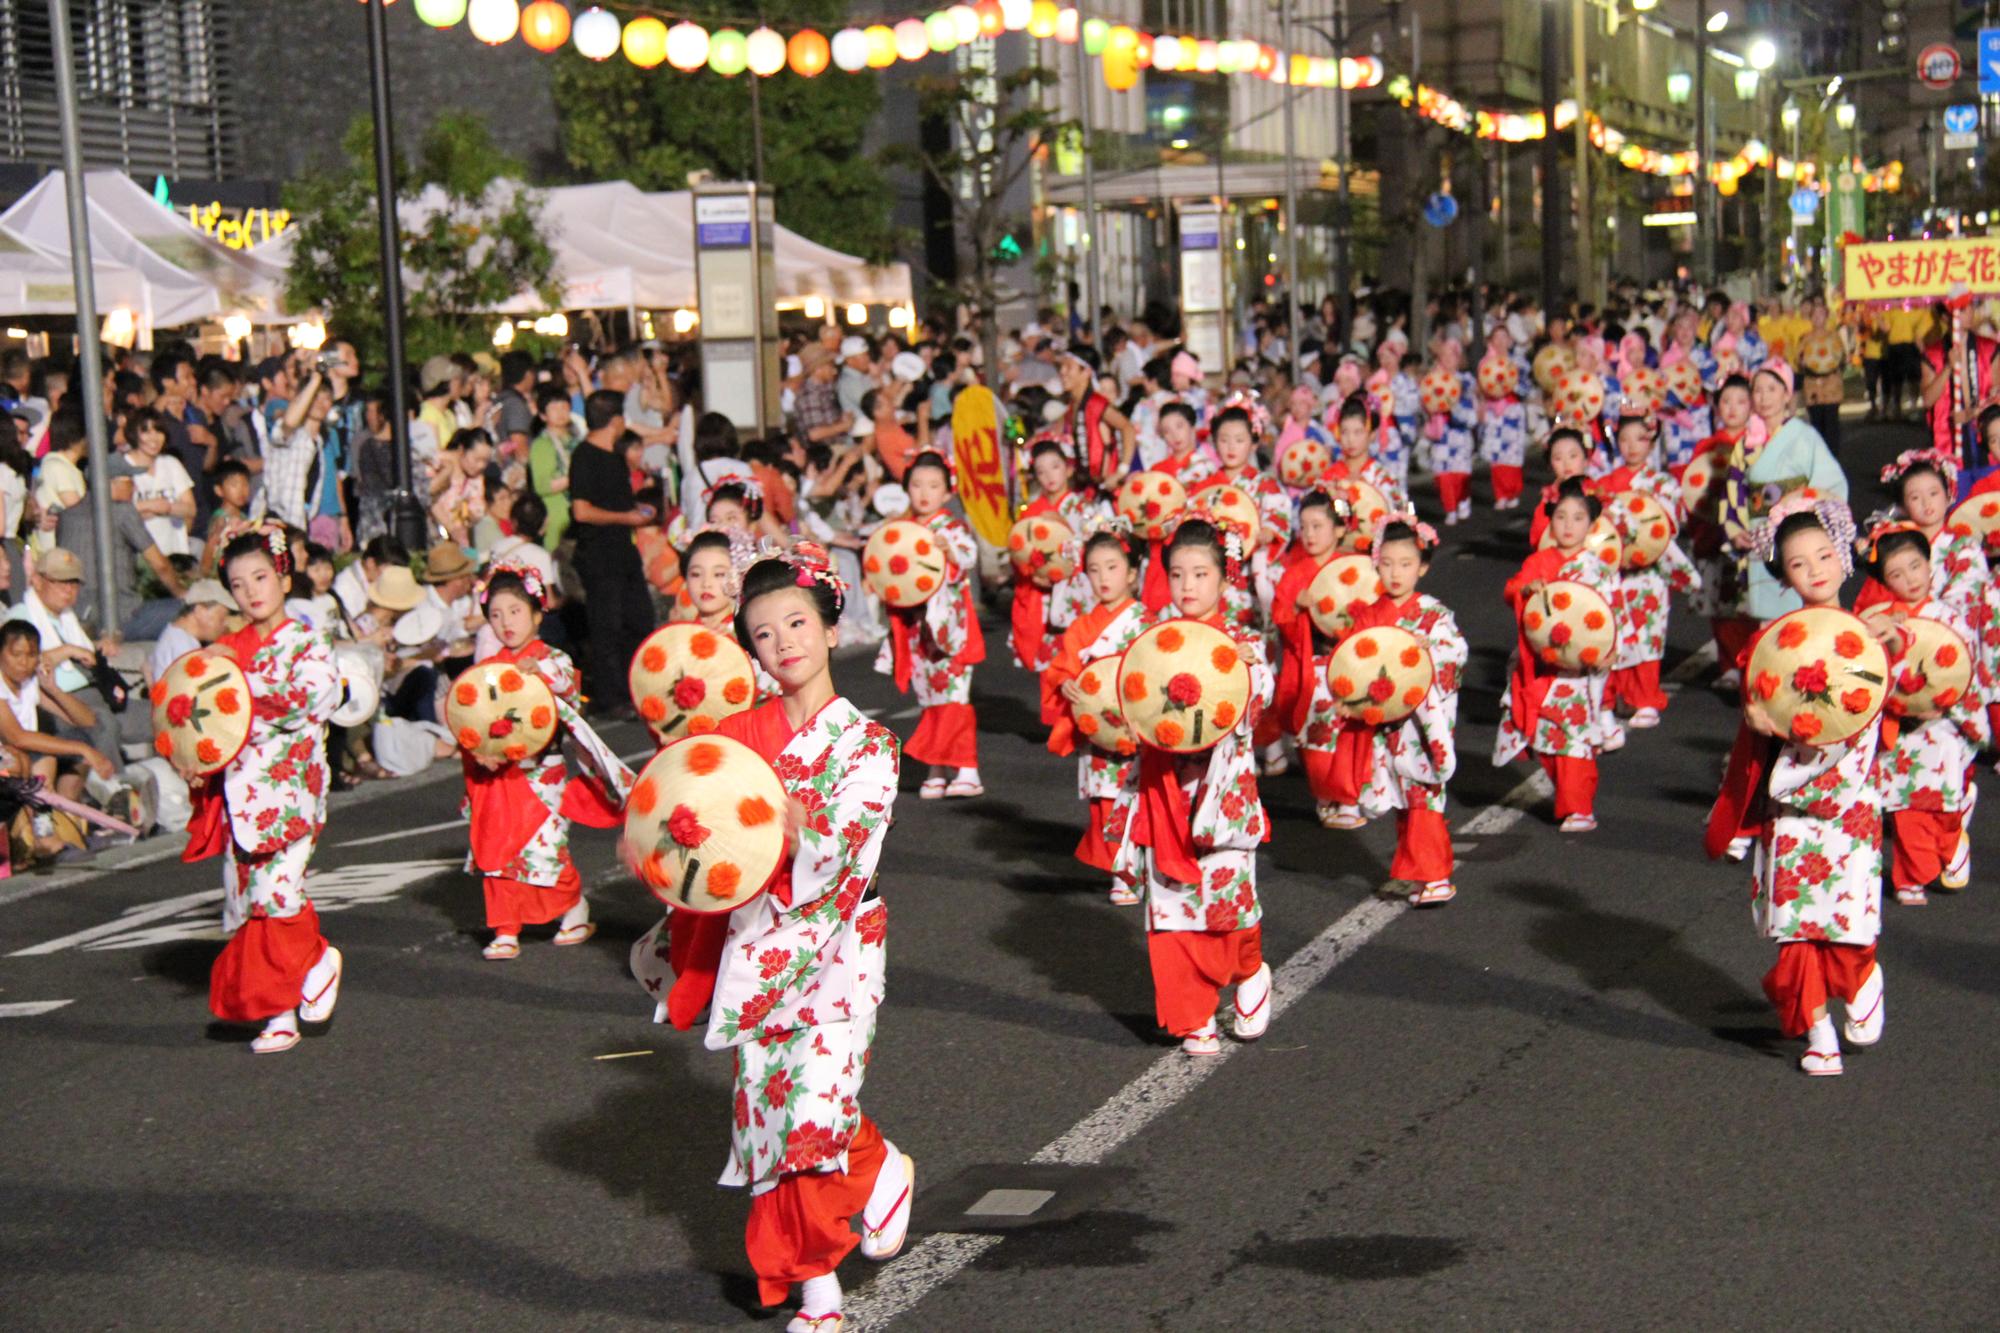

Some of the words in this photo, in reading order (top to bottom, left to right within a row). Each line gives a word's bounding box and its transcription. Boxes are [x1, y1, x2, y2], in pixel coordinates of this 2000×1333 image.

[1857, 246, 2000, 290] やまがた花
